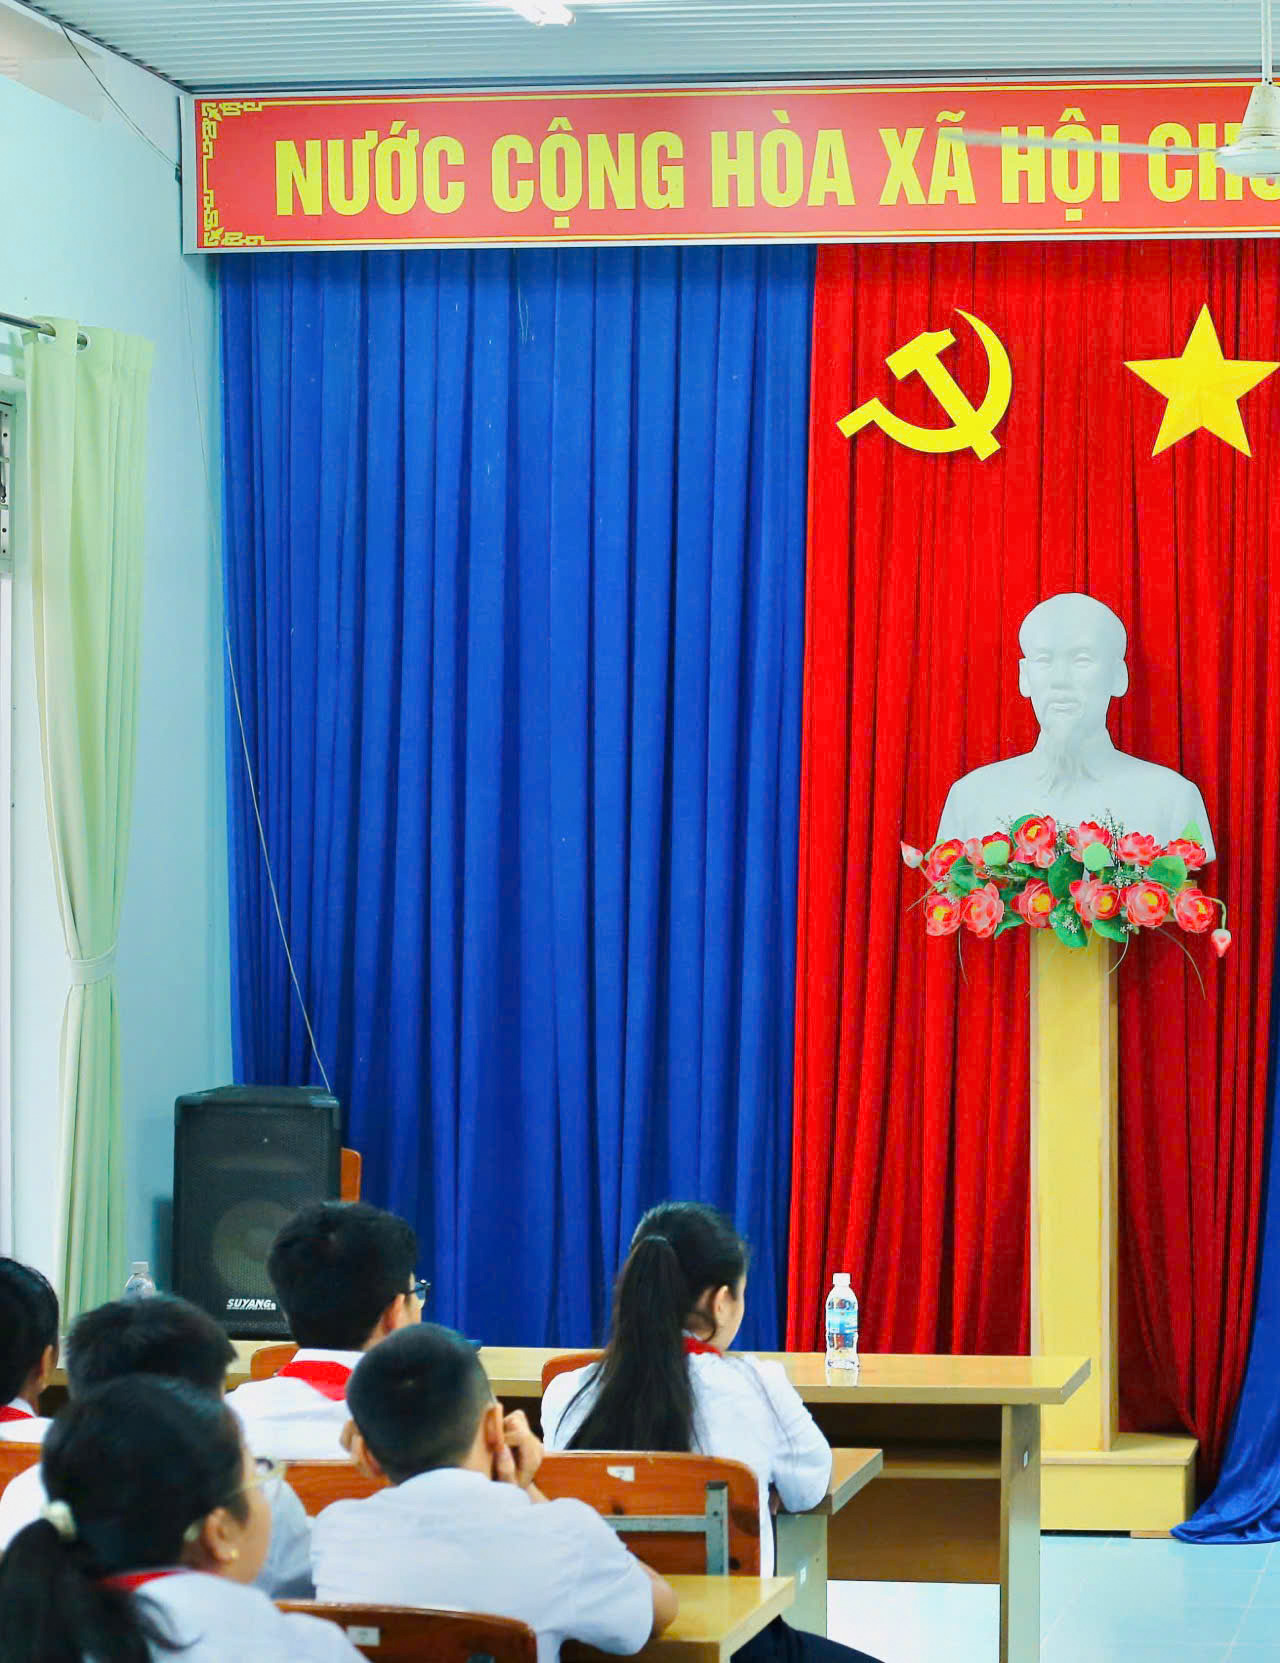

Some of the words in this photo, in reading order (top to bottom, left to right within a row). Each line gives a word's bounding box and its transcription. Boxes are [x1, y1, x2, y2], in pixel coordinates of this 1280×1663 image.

[275, 119, 466, 217] NƯỚC
[491, 116, 685, 229] CỘNG
[711, 110, 856, 210] HÒA
[878, 110, 977, 206] XÃ
[1001, 108, 1121, 222] HỘI
[226, 1298, 272, 1310] SUYANG
